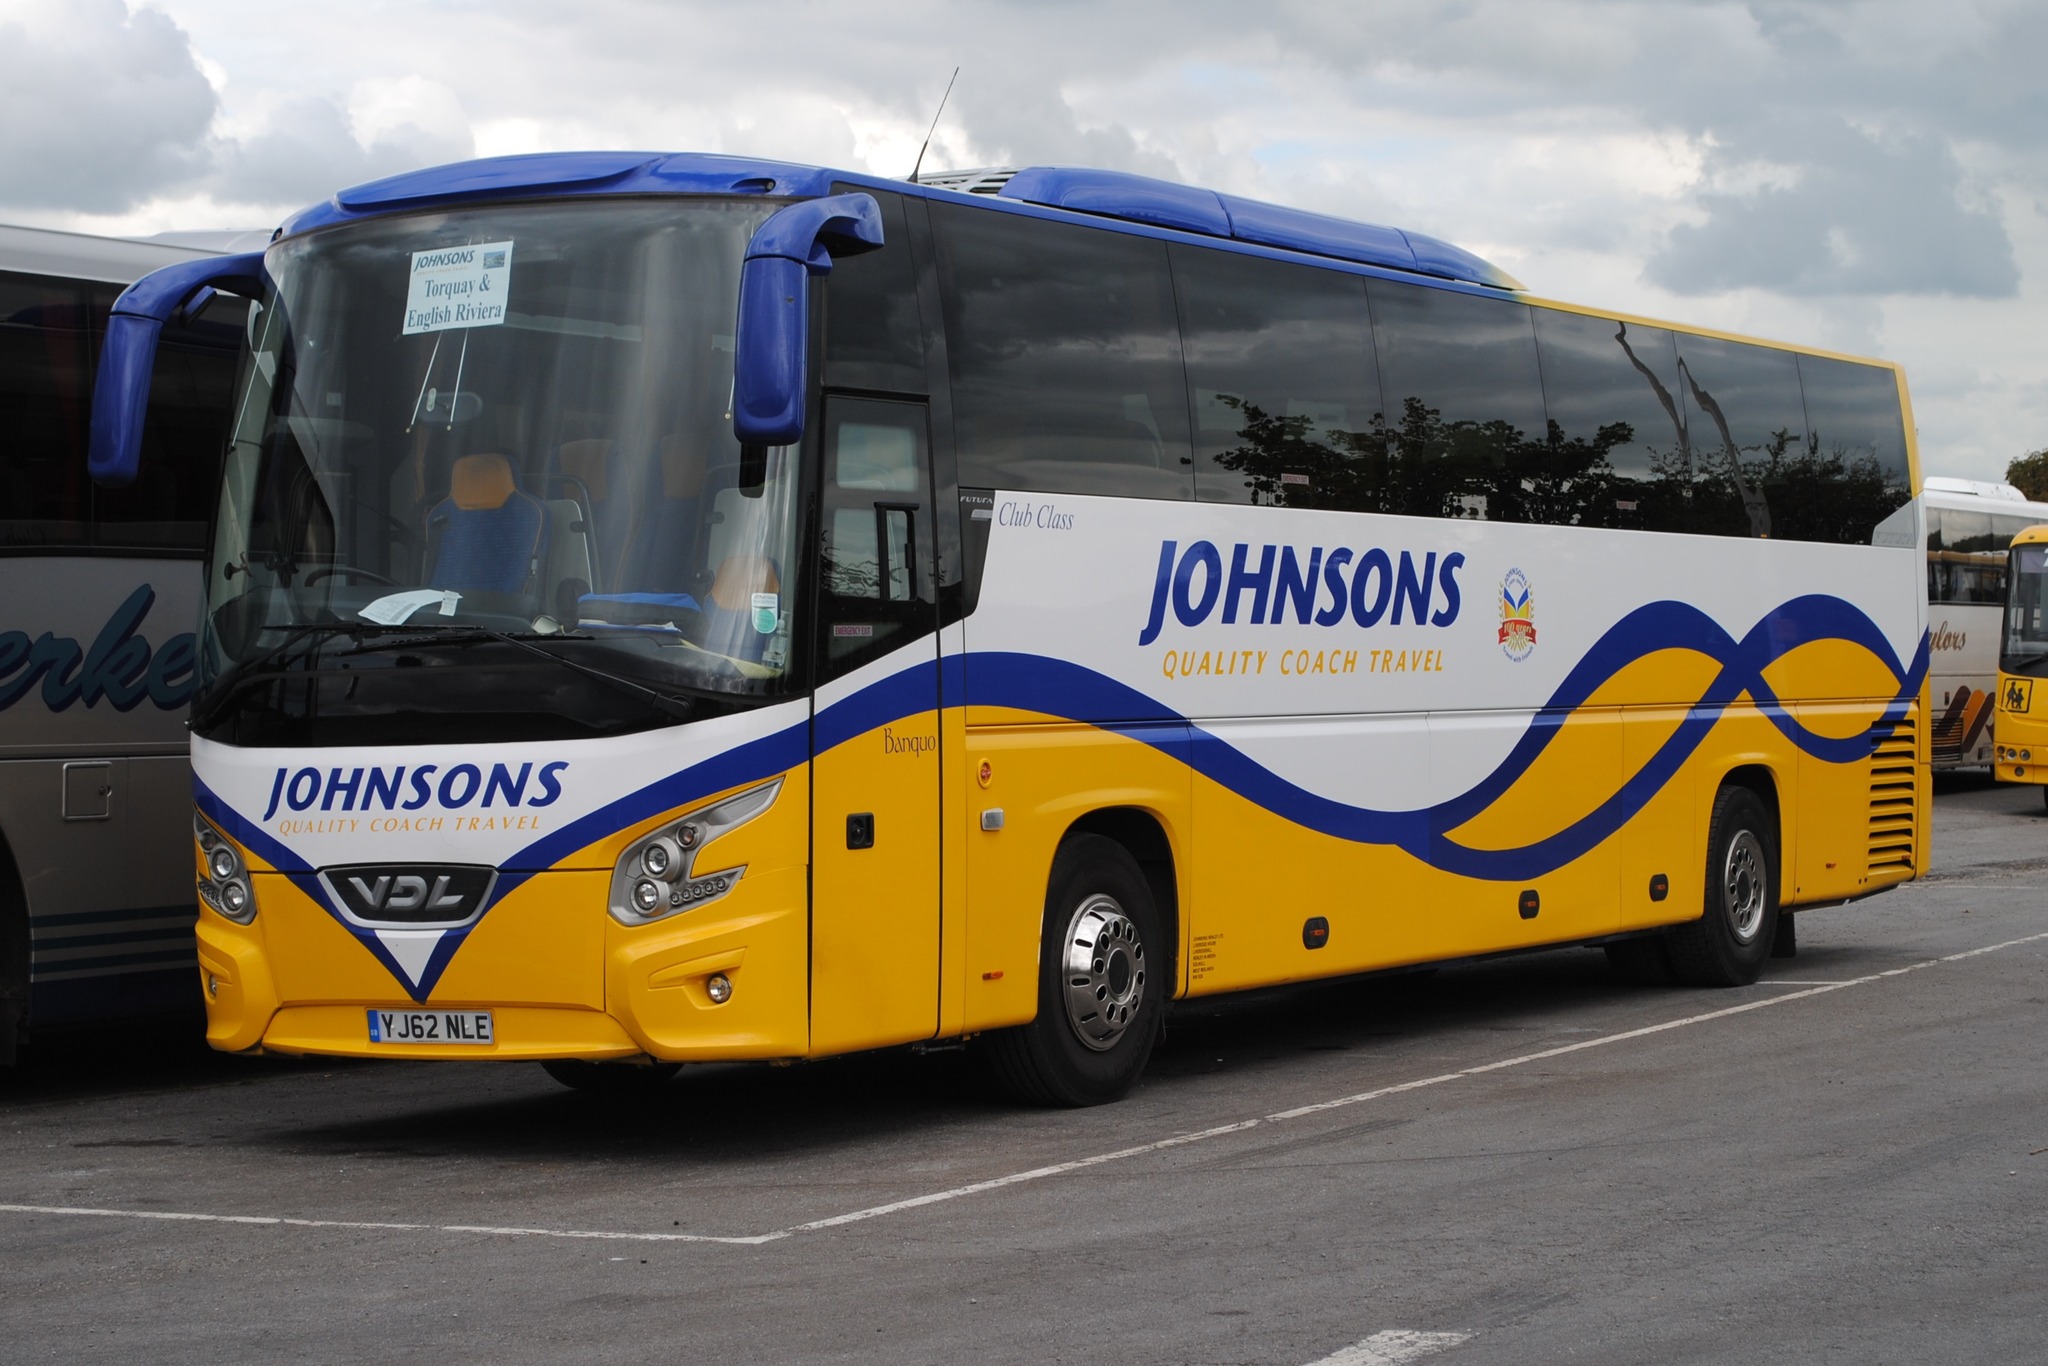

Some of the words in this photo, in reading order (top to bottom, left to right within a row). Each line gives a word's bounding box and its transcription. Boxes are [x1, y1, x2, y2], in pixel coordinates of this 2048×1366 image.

[413, 250, 475, 272] JOHNSONS
[425, 279, 476, 300] Torquay
[479, 273, 491, 292] &
[407, 305, 452, 330] English
[455, 301, 502, 322] Riviera
[960, 496, 993, 504] FUTURA
[999, 501, 1033, 527] Club
[1036, 504, 1075, 530] Class
[1138, 540, 1466, 646] JOHNSONS
[1163, 650, 1268, 680] QUALITY
[1280, 649, 1358, 675] COACH
[1370, 650, 1443, 673] TRAVEL
[884, 727, 936, 758] Banquo
[263, 761, 570, 822] JOHNSONS
[279, 818, 360, 837] QUALITY
[370, 817, 443, 832] COACH
[455, 815, 540, 831] TRAVEL
[347, 875, 465, 911] VDL
[381, 1014, 439, 1039] YJ62
[445, 1015, 490, 1040] NLE
